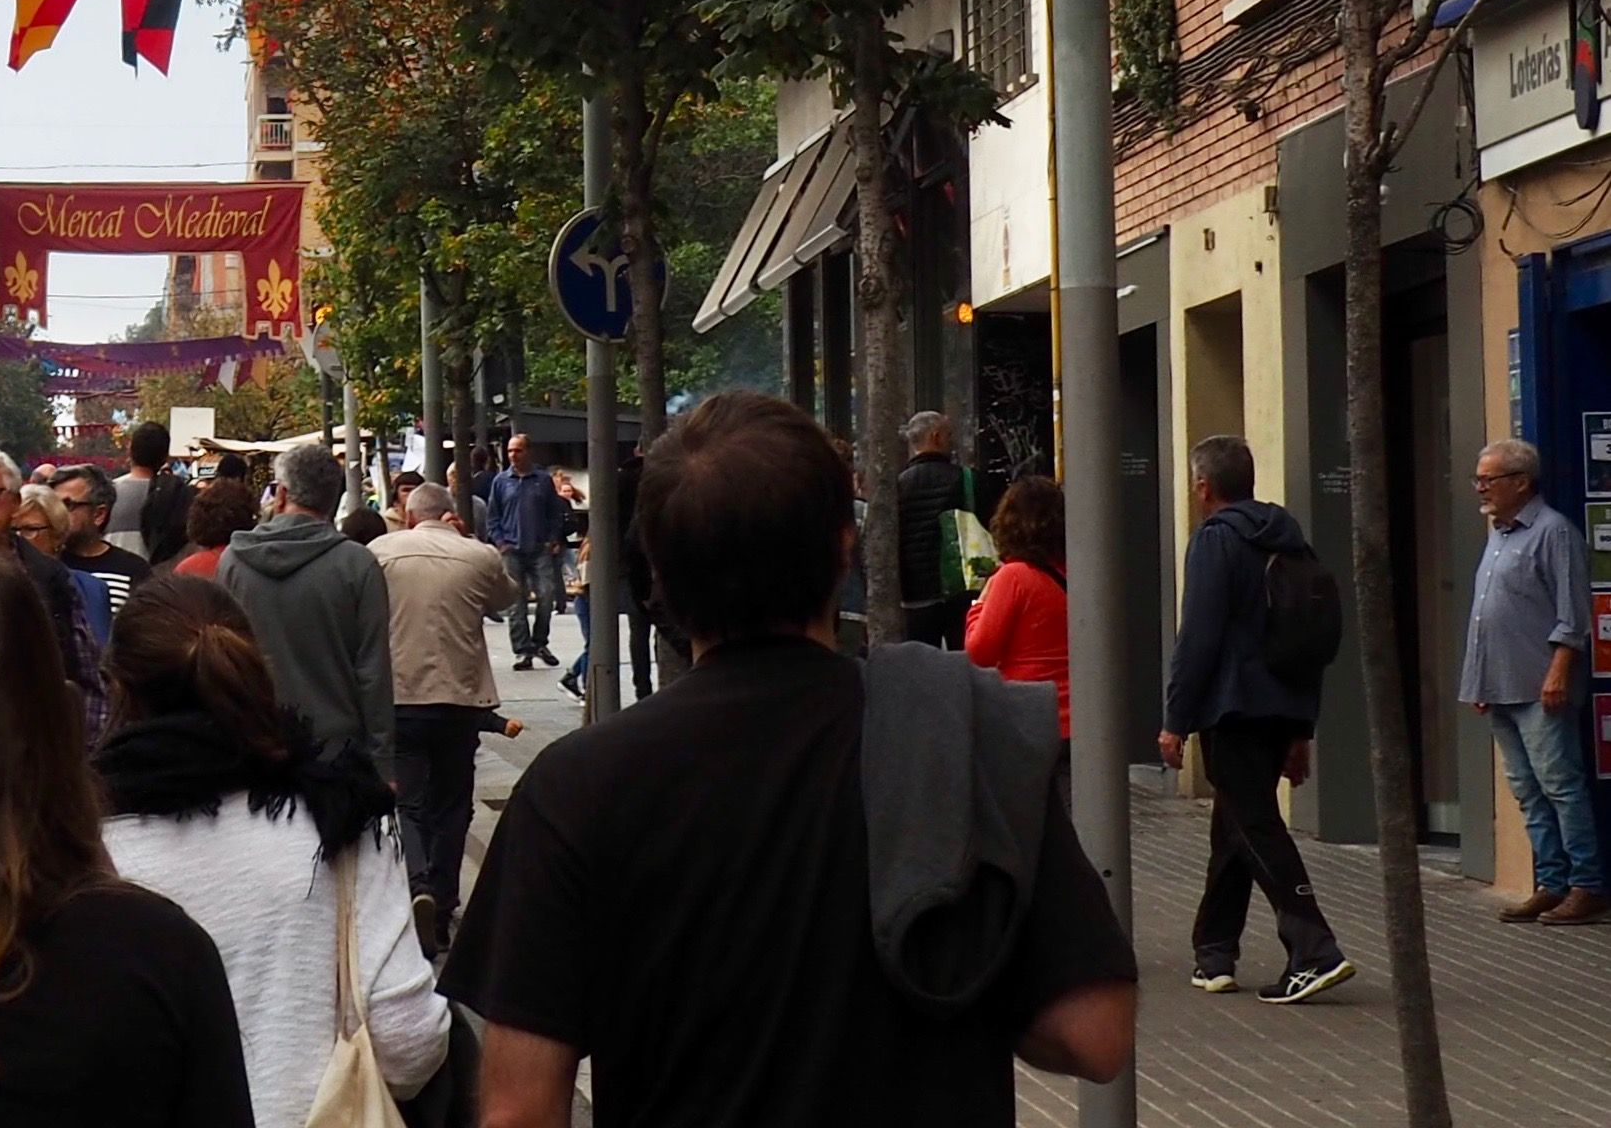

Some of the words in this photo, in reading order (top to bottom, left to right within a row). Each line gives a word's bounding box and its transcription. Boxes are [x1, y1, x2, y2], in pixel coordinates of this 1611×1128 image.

[1509, 32, 1561, 99] Loterías
[17, 193, 126, 238] Mercat
[134, 193, 273, 239] Medieval
